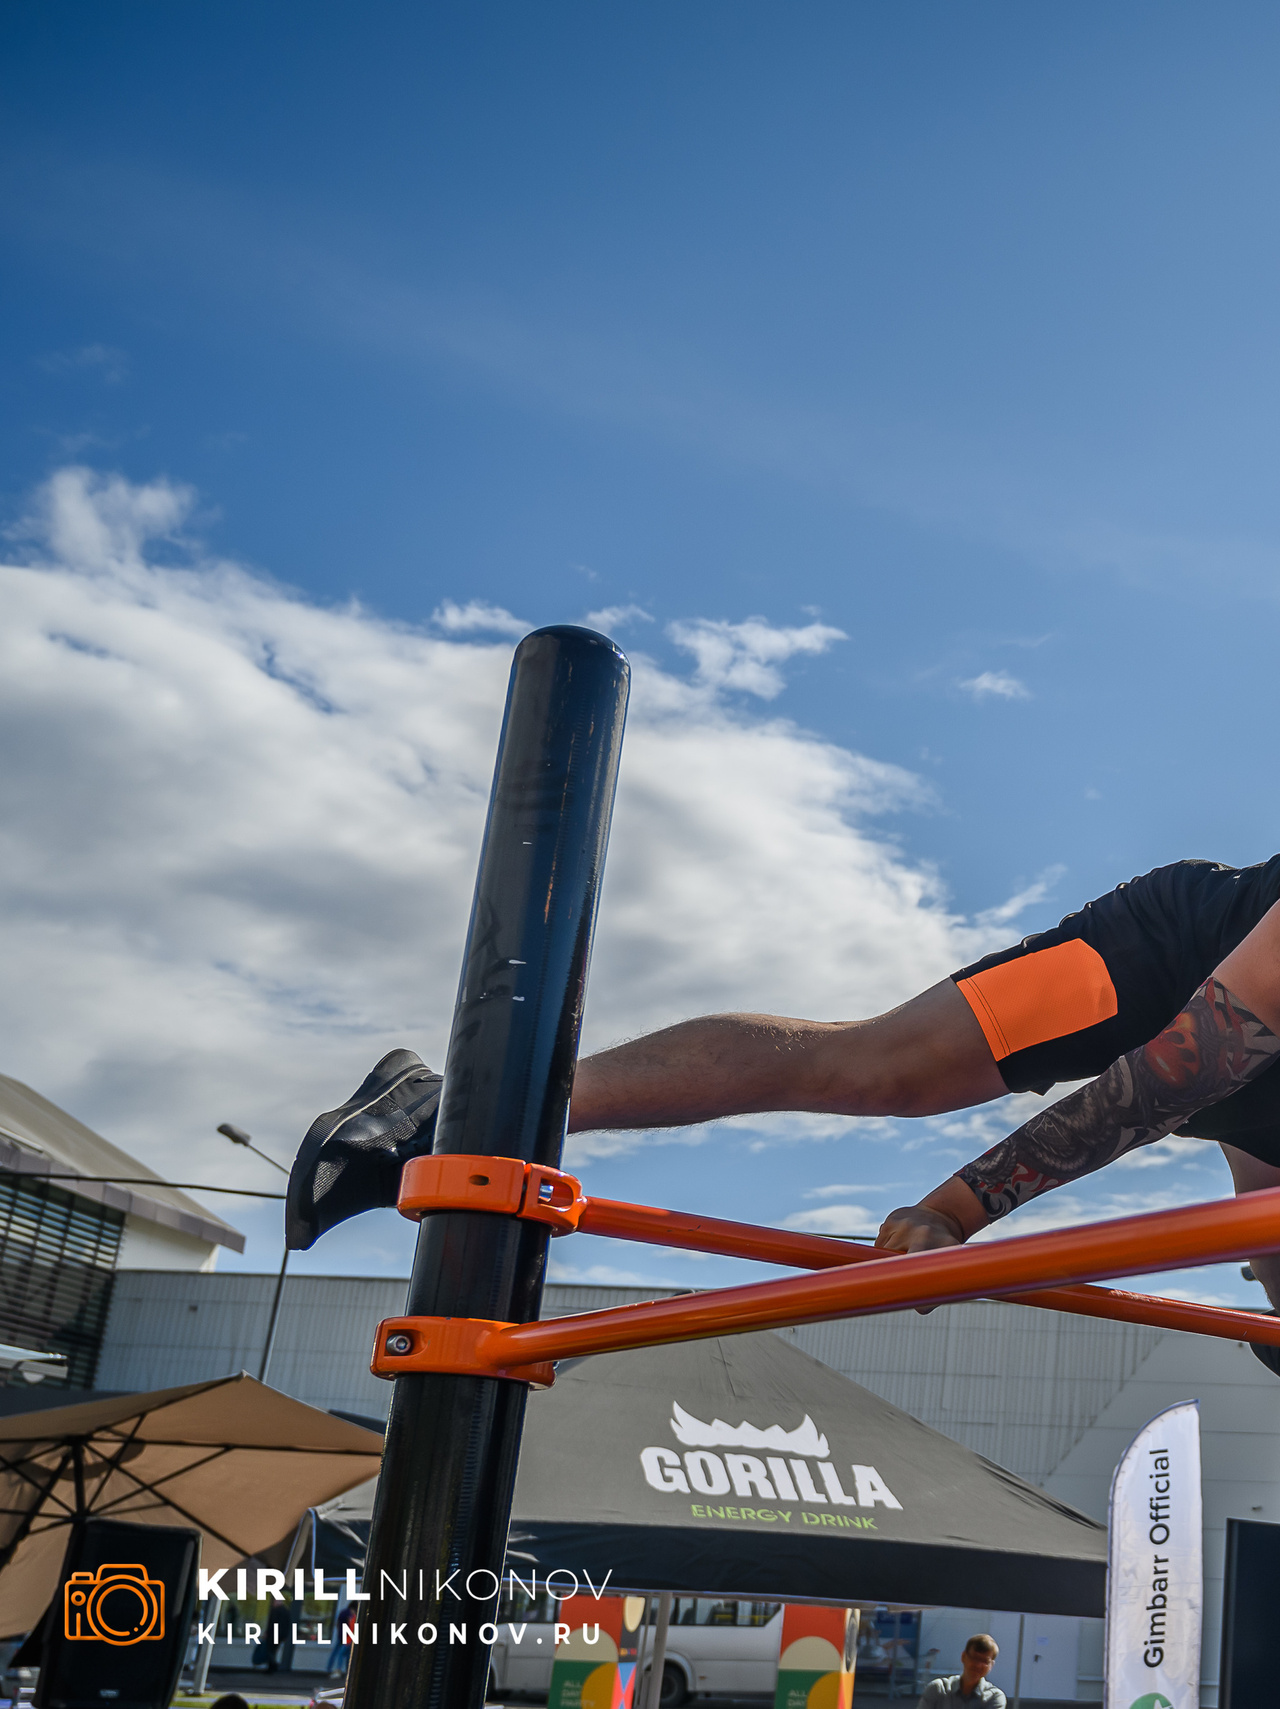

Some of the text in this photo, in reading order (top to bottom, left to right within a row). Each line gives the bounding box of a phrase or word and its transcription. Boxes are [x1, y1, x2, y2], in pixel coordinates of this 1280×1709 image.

[639, 1446, 904, 1511] GORILLA
[691, 1504, 879, 1530] ENERGY DRINK
[1143, 1448, 1170, 1668] Gimbarr Official
